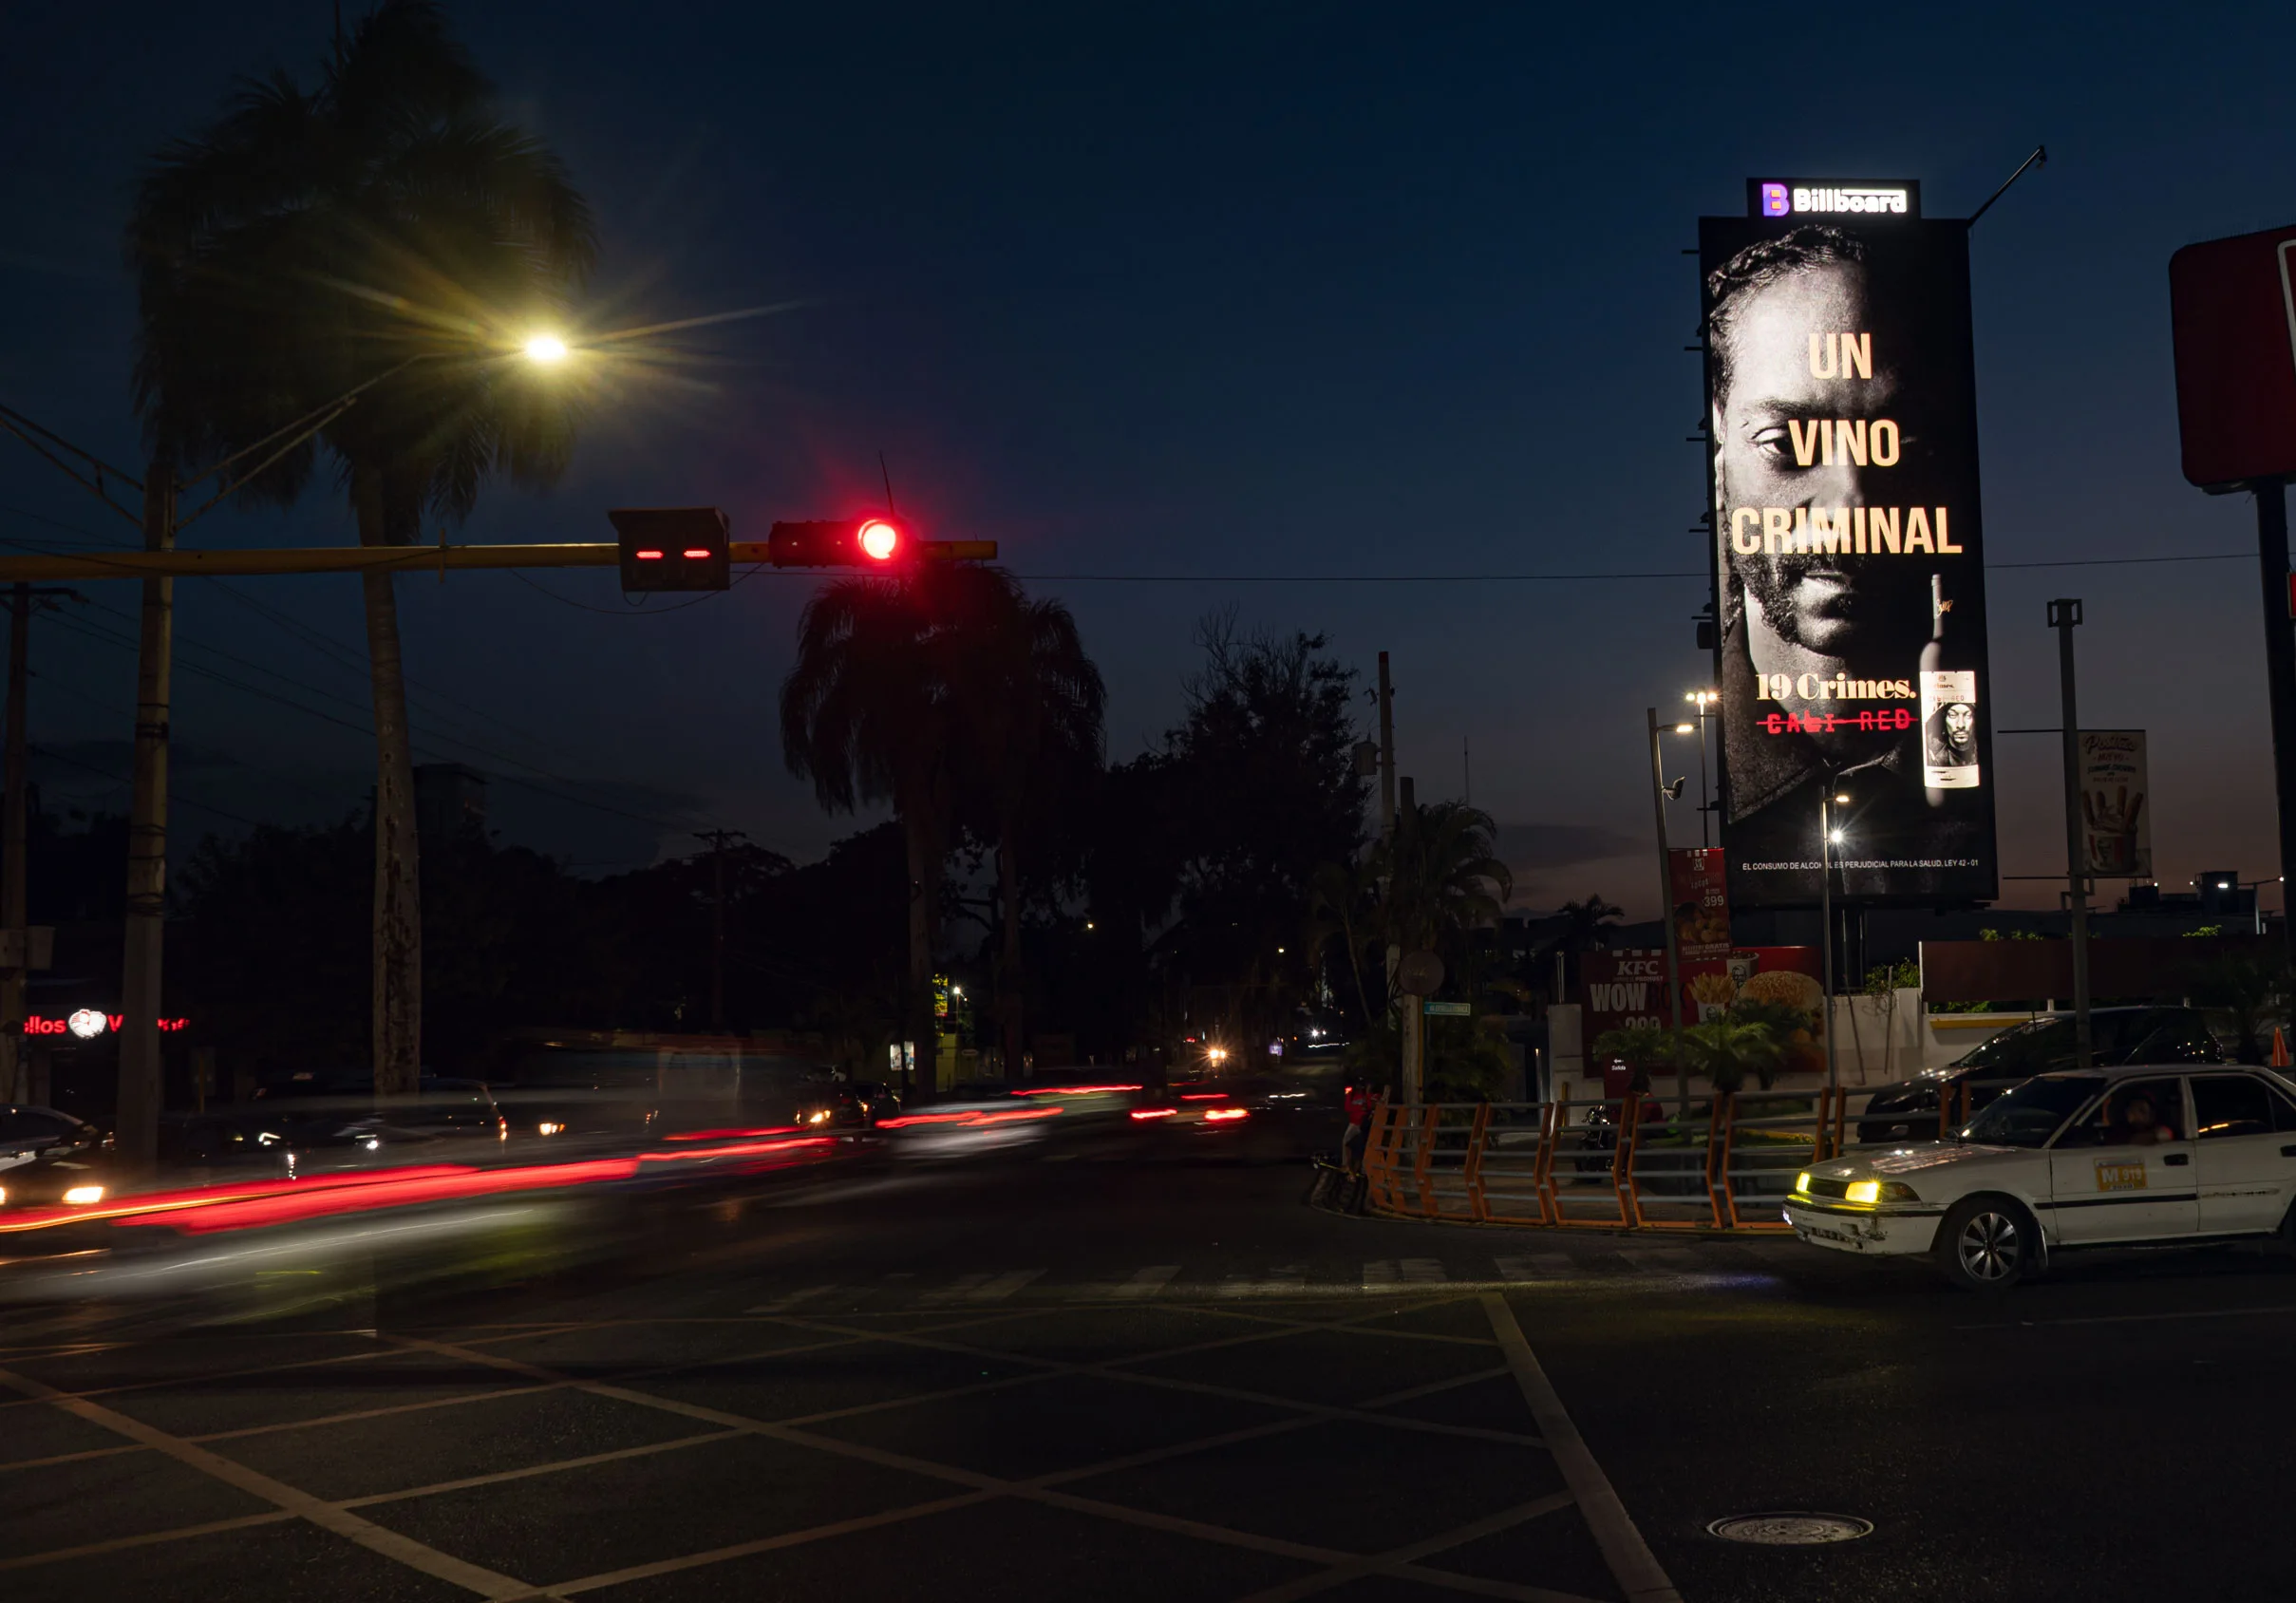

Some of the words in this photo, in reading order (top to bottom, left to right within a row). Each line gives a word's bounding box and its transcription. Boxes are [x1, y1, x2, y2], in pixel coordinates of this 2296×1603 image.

[1793, 188, 1908, 214] Billboard
[1809, 332, 1873, 379] UN
[1788, 419, 1900, 467] VINO
[1731, 507, 1964, 555] CRIMINAL
[1756, 673, 1792, 701] 19
[1797, 672, 1917, 700] Crimes.
[1766, 711, 1835, 735] CALI
[1859, 707, 1910, 732] RED
[1741, 862, 1752, 871] EL
[1752, 861, 1789, 871] CONSUMO
[1789, 861, 1799, 870] DE
[1834, 860, 1844, 869] ES
[1844, 860, 1890, 869] PERJUDICIAL
[1617, 960, 1659, 976] KFC
[1590, 983, 1647, 1012] WOW
